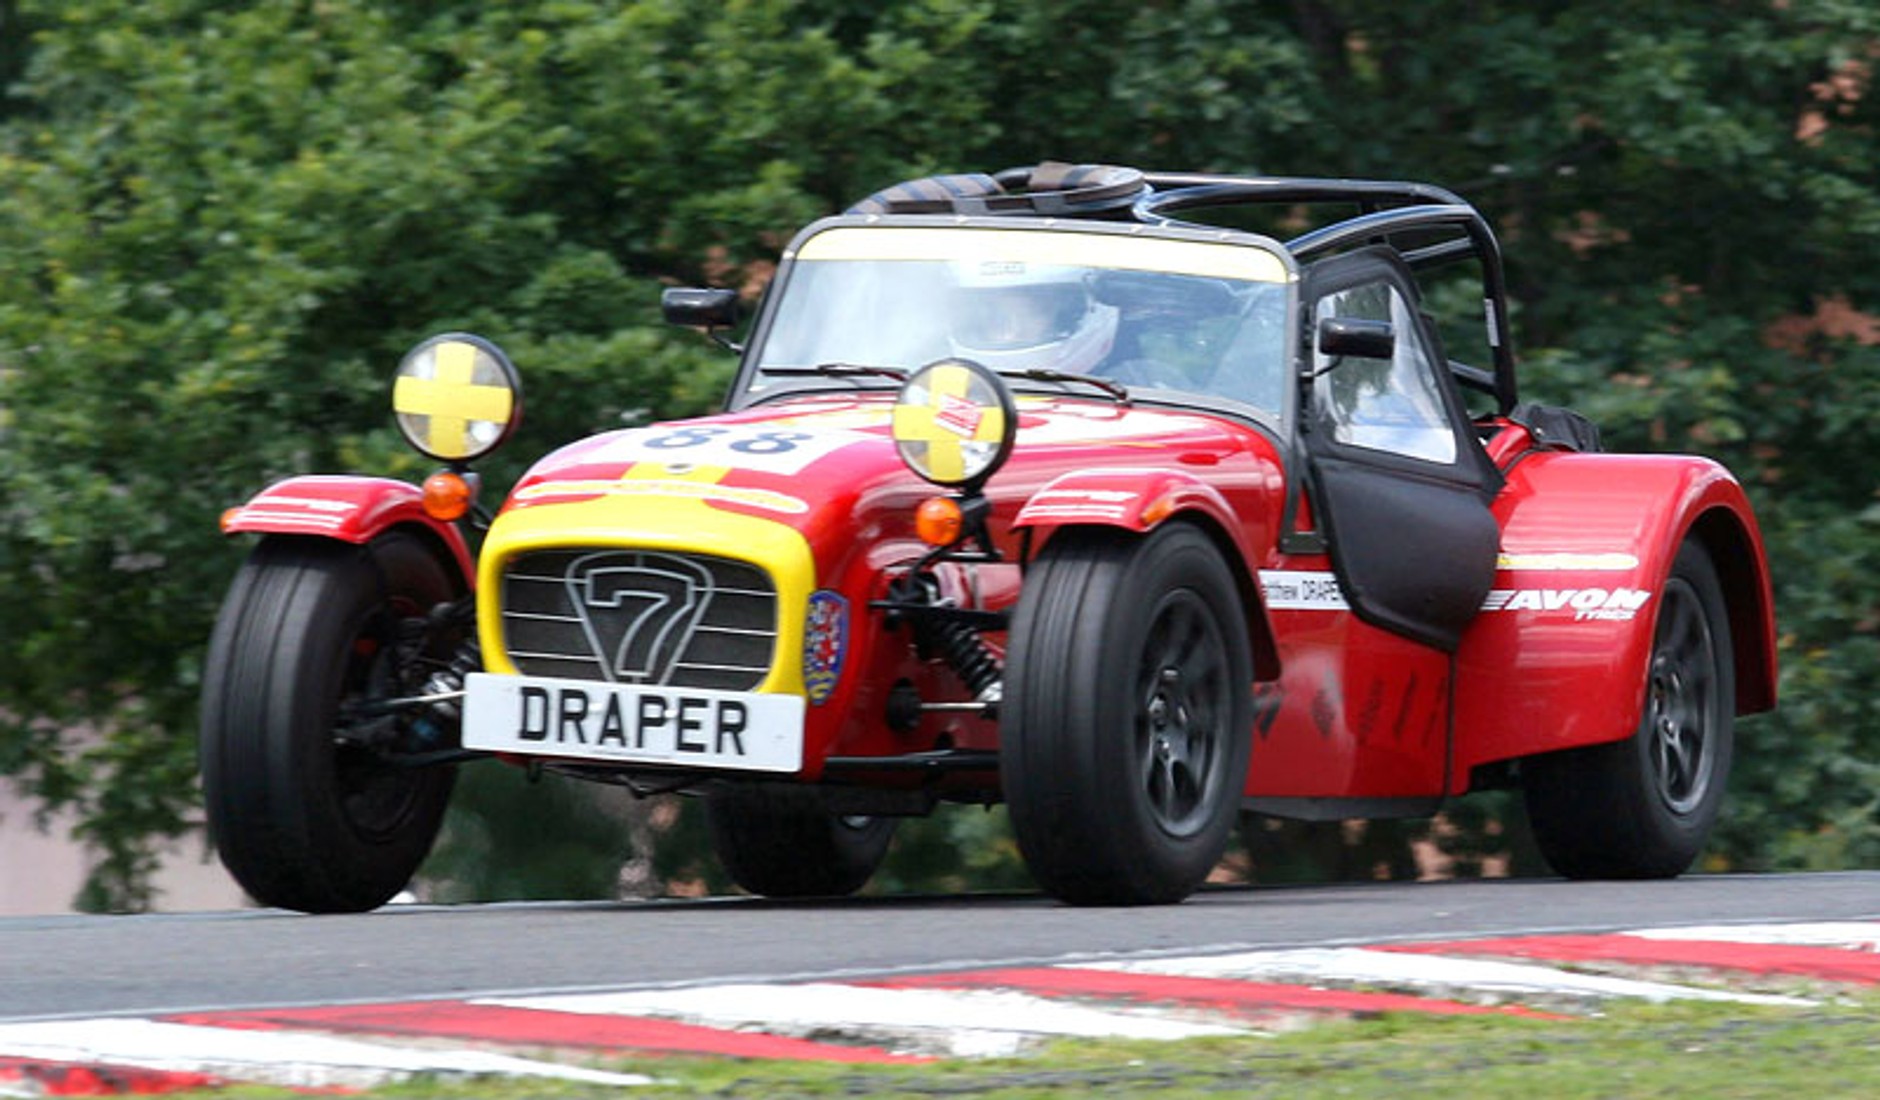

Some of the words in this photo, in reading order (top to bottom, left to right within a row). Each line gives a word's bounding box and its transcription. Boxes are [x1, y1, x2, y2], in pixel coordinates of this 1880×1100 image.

[585, 567, 696, 678] 7
[1503, 587, 1651, 611] AVON
[518, 685, 747, 757] DRAPER
